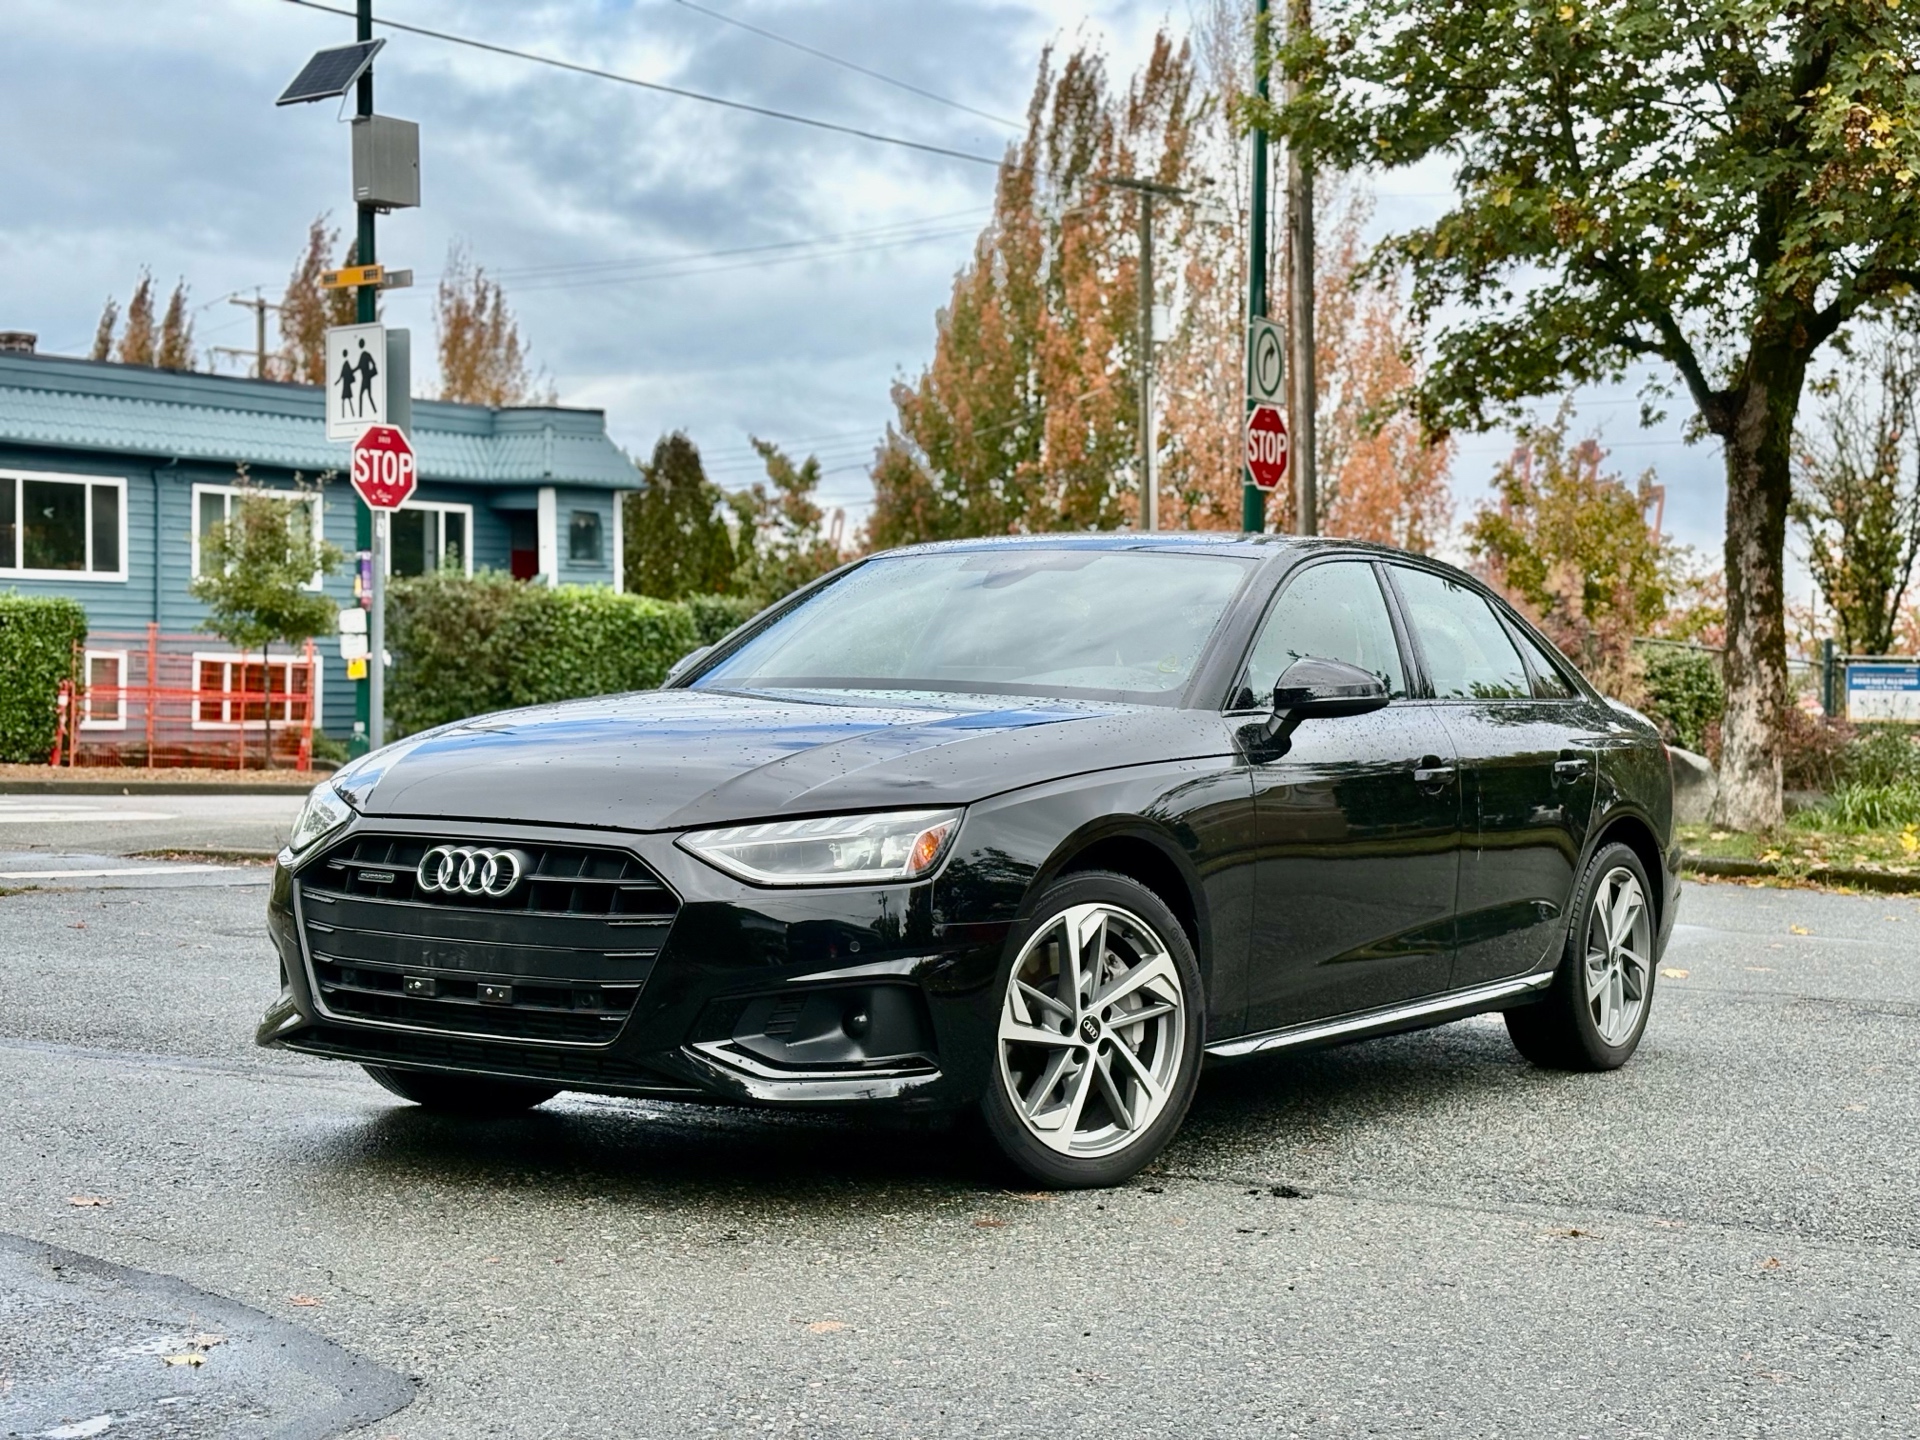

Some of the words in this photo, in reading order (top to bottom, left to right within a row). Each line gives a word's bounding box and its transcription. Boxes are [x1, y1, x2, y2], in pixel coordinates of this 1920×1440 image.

[1249, 429, 1287, 465] STOP
[355, 447, 413, 487] STOP
[1886, 677, 1919, 686] ALLOWED
[360, 872, 392, 881] quattro
[1170, 927, 1199, 990] Continental
